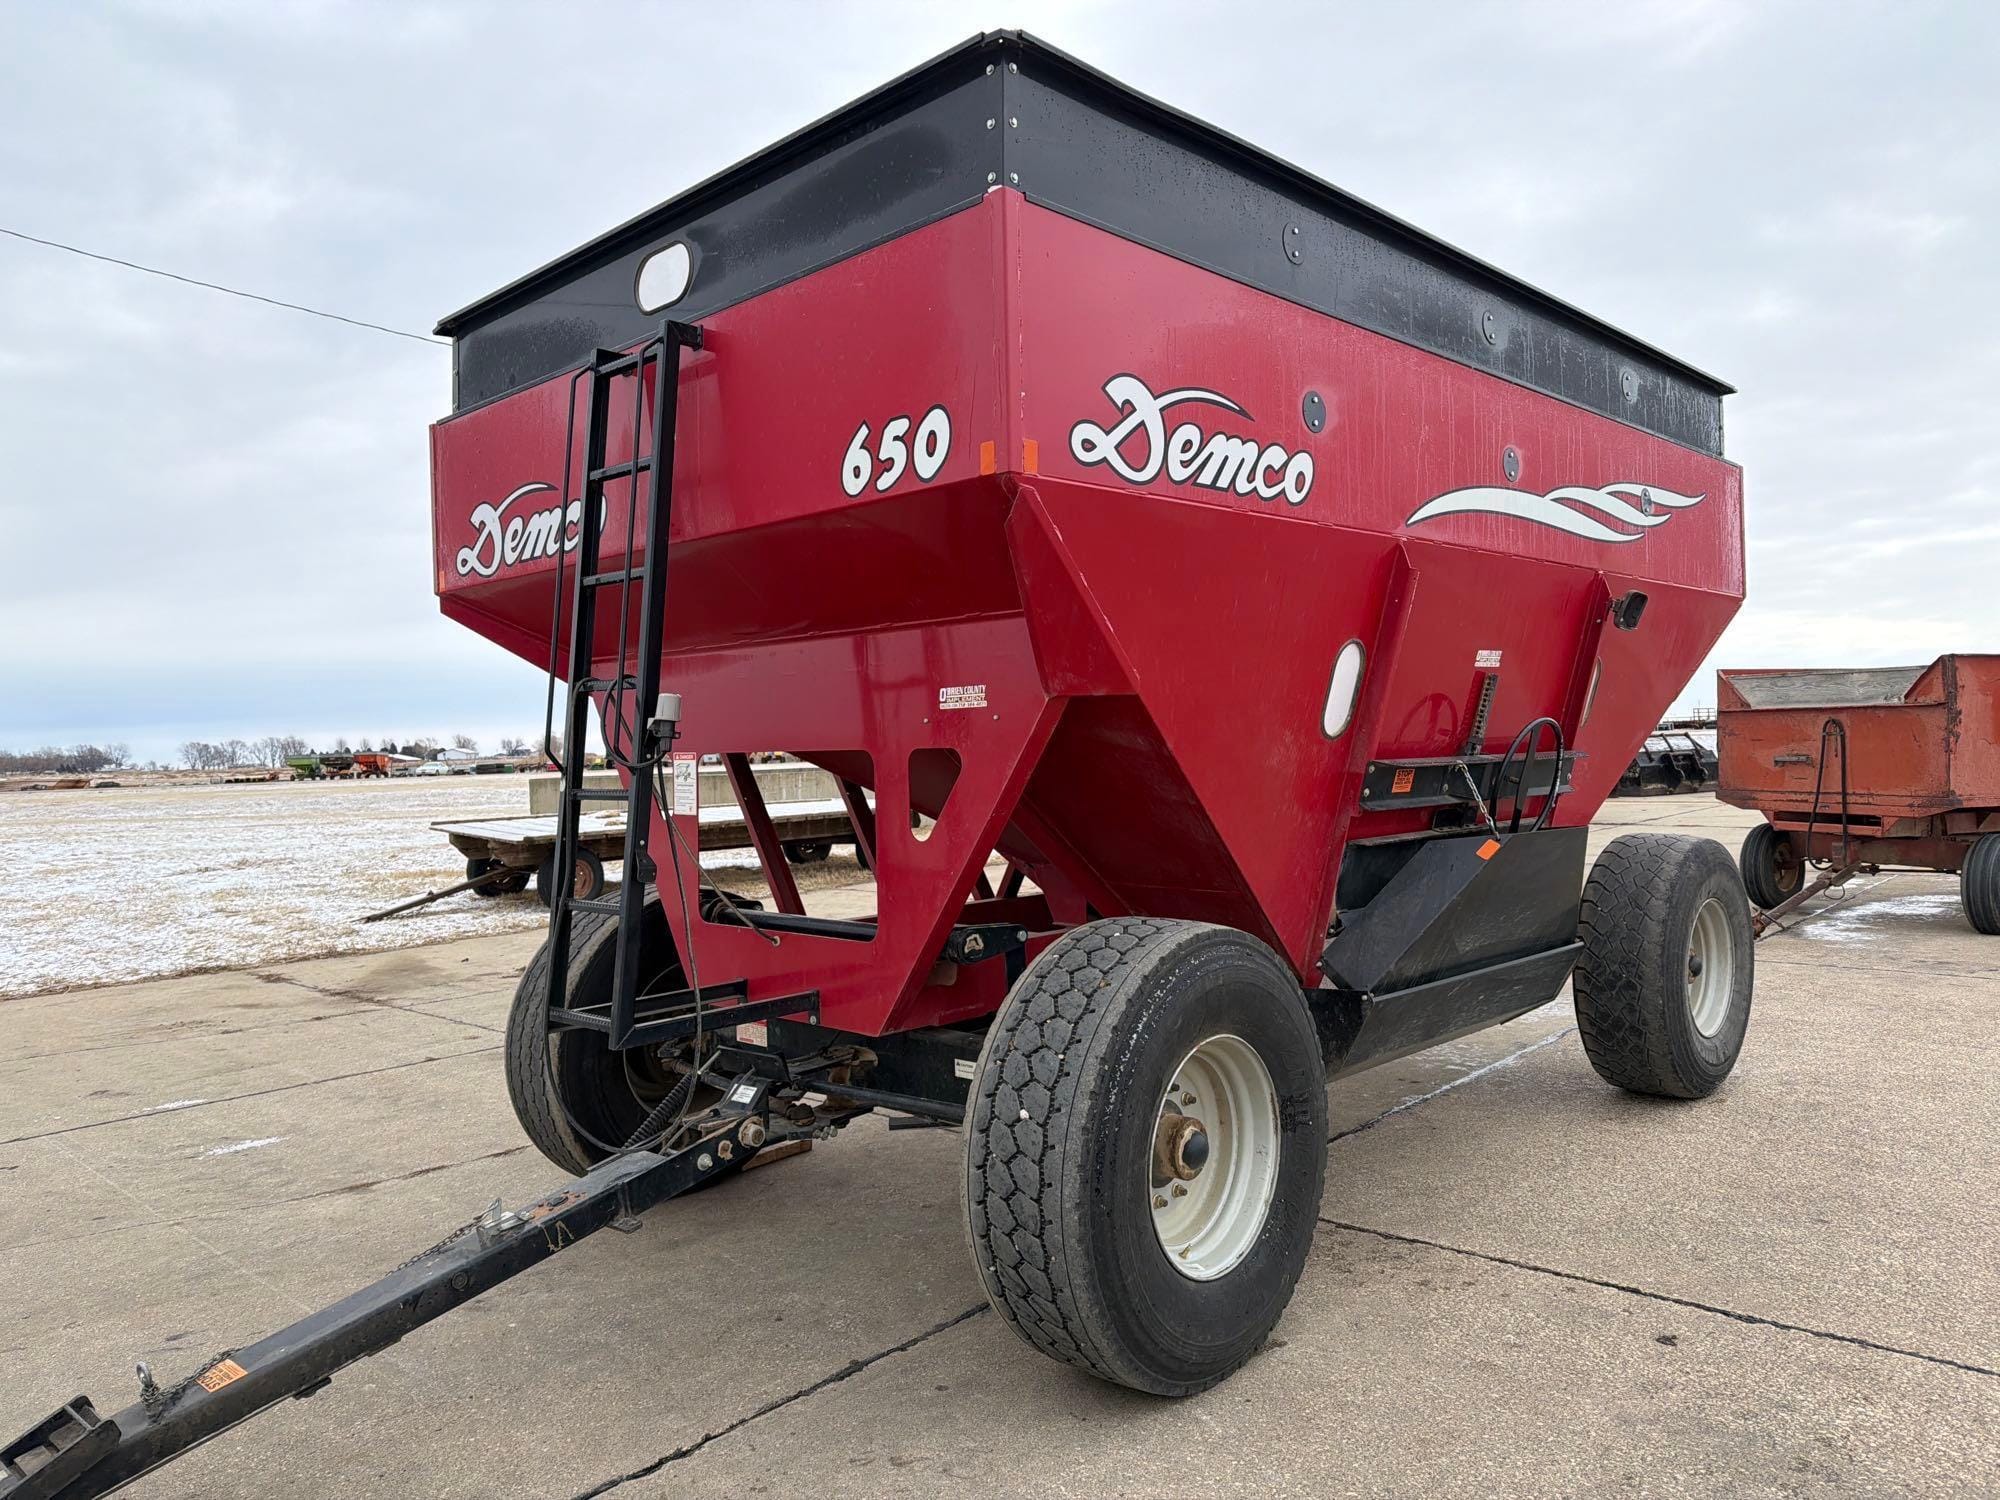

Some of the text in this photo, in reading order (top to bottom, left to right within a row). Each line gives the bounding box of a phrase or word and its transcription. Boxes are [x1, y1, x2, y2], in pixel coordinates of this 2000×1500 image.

[841, 403, 952, 498] 650
[1069, 372, 1315, 506] Demco
[946, 695, 985, 703] IMPLEMENT
[964, 685, 986, 695] COUNTY
